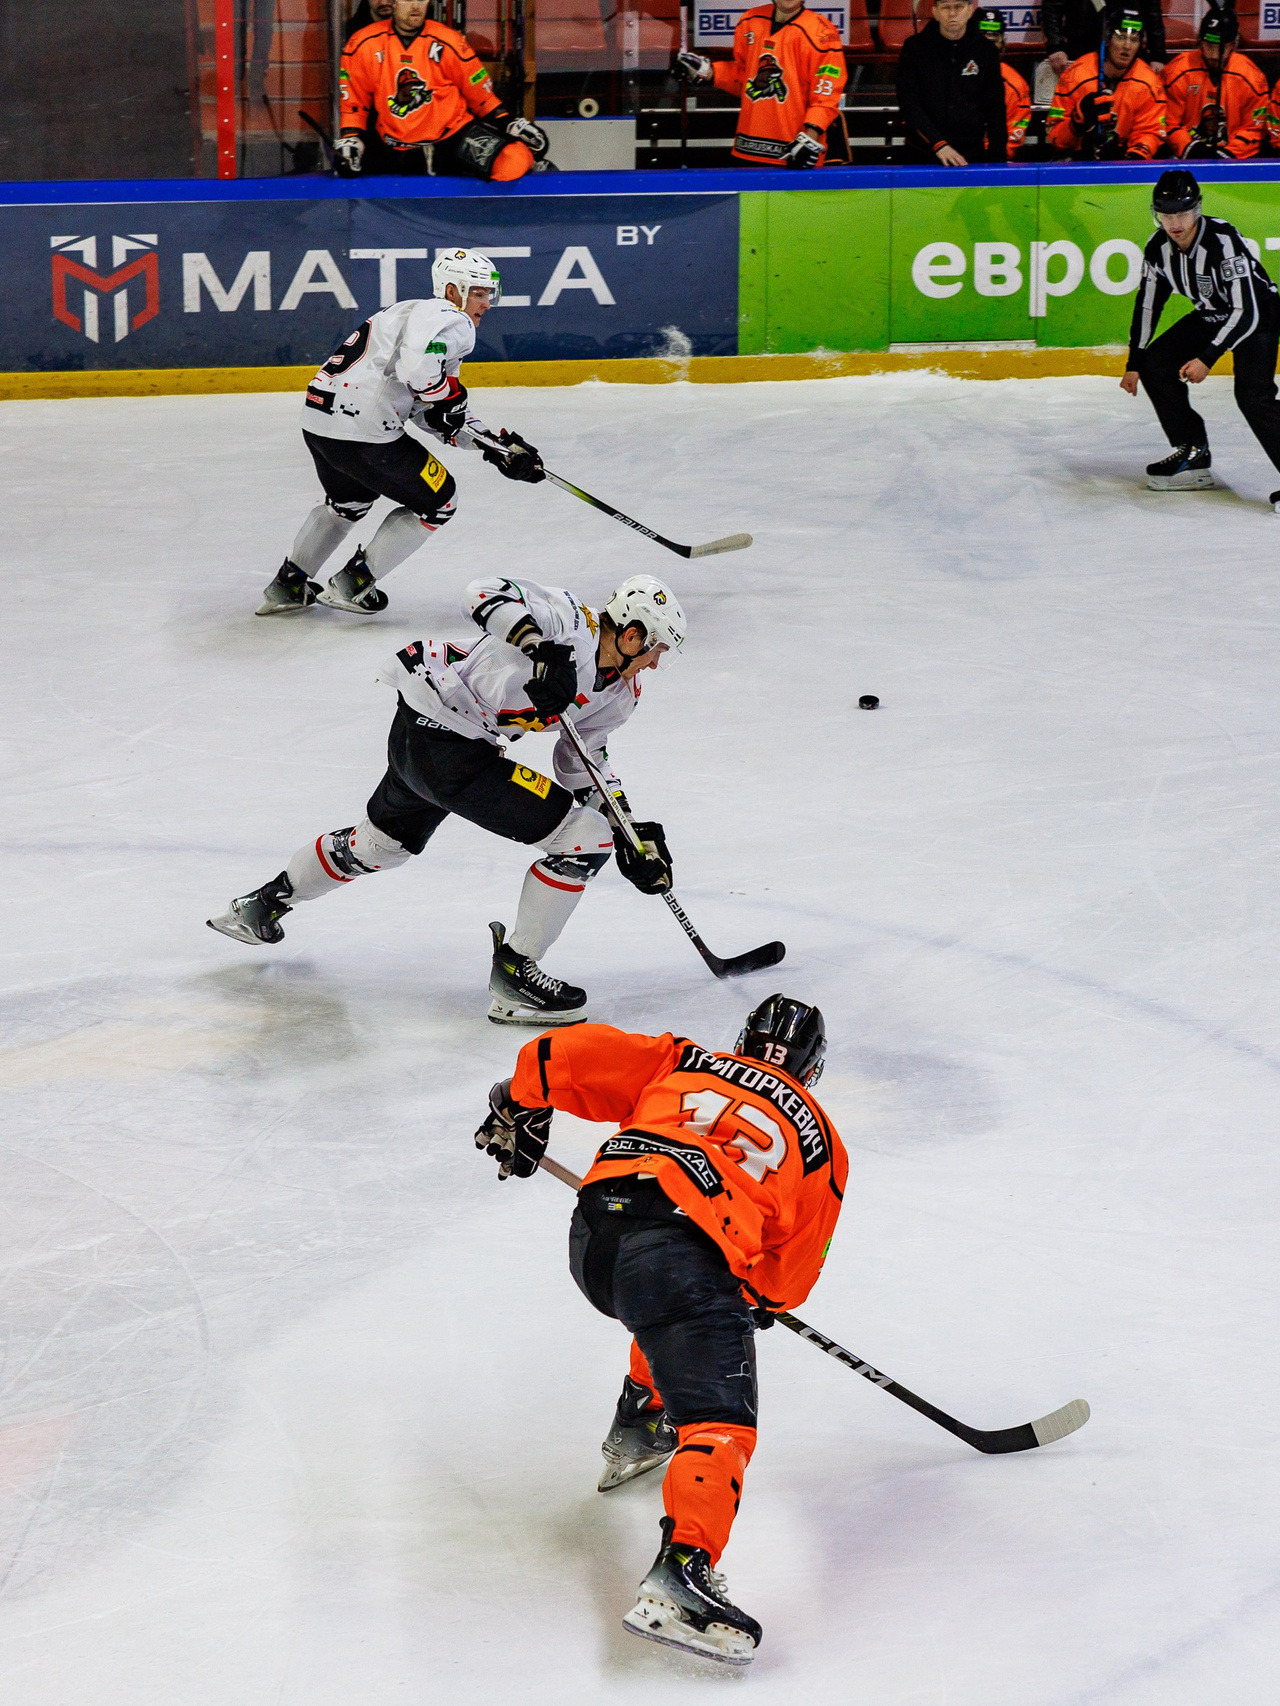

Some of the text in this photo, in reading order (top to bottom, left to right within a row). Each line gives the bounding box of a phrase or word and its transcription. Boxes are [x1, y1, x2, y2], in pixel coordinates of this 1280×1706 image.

[616, 225, 662, 246] BY
[1221, 257, 1247, 280] 66
[612, 513, 658, 539] BAUER
[664, 891, 697, 940] BAUER
[519, 987, 546, 1006] BAUER
[764, 1042, 788, 1066] 13
[800, 1327, 893, 1388] CCM
